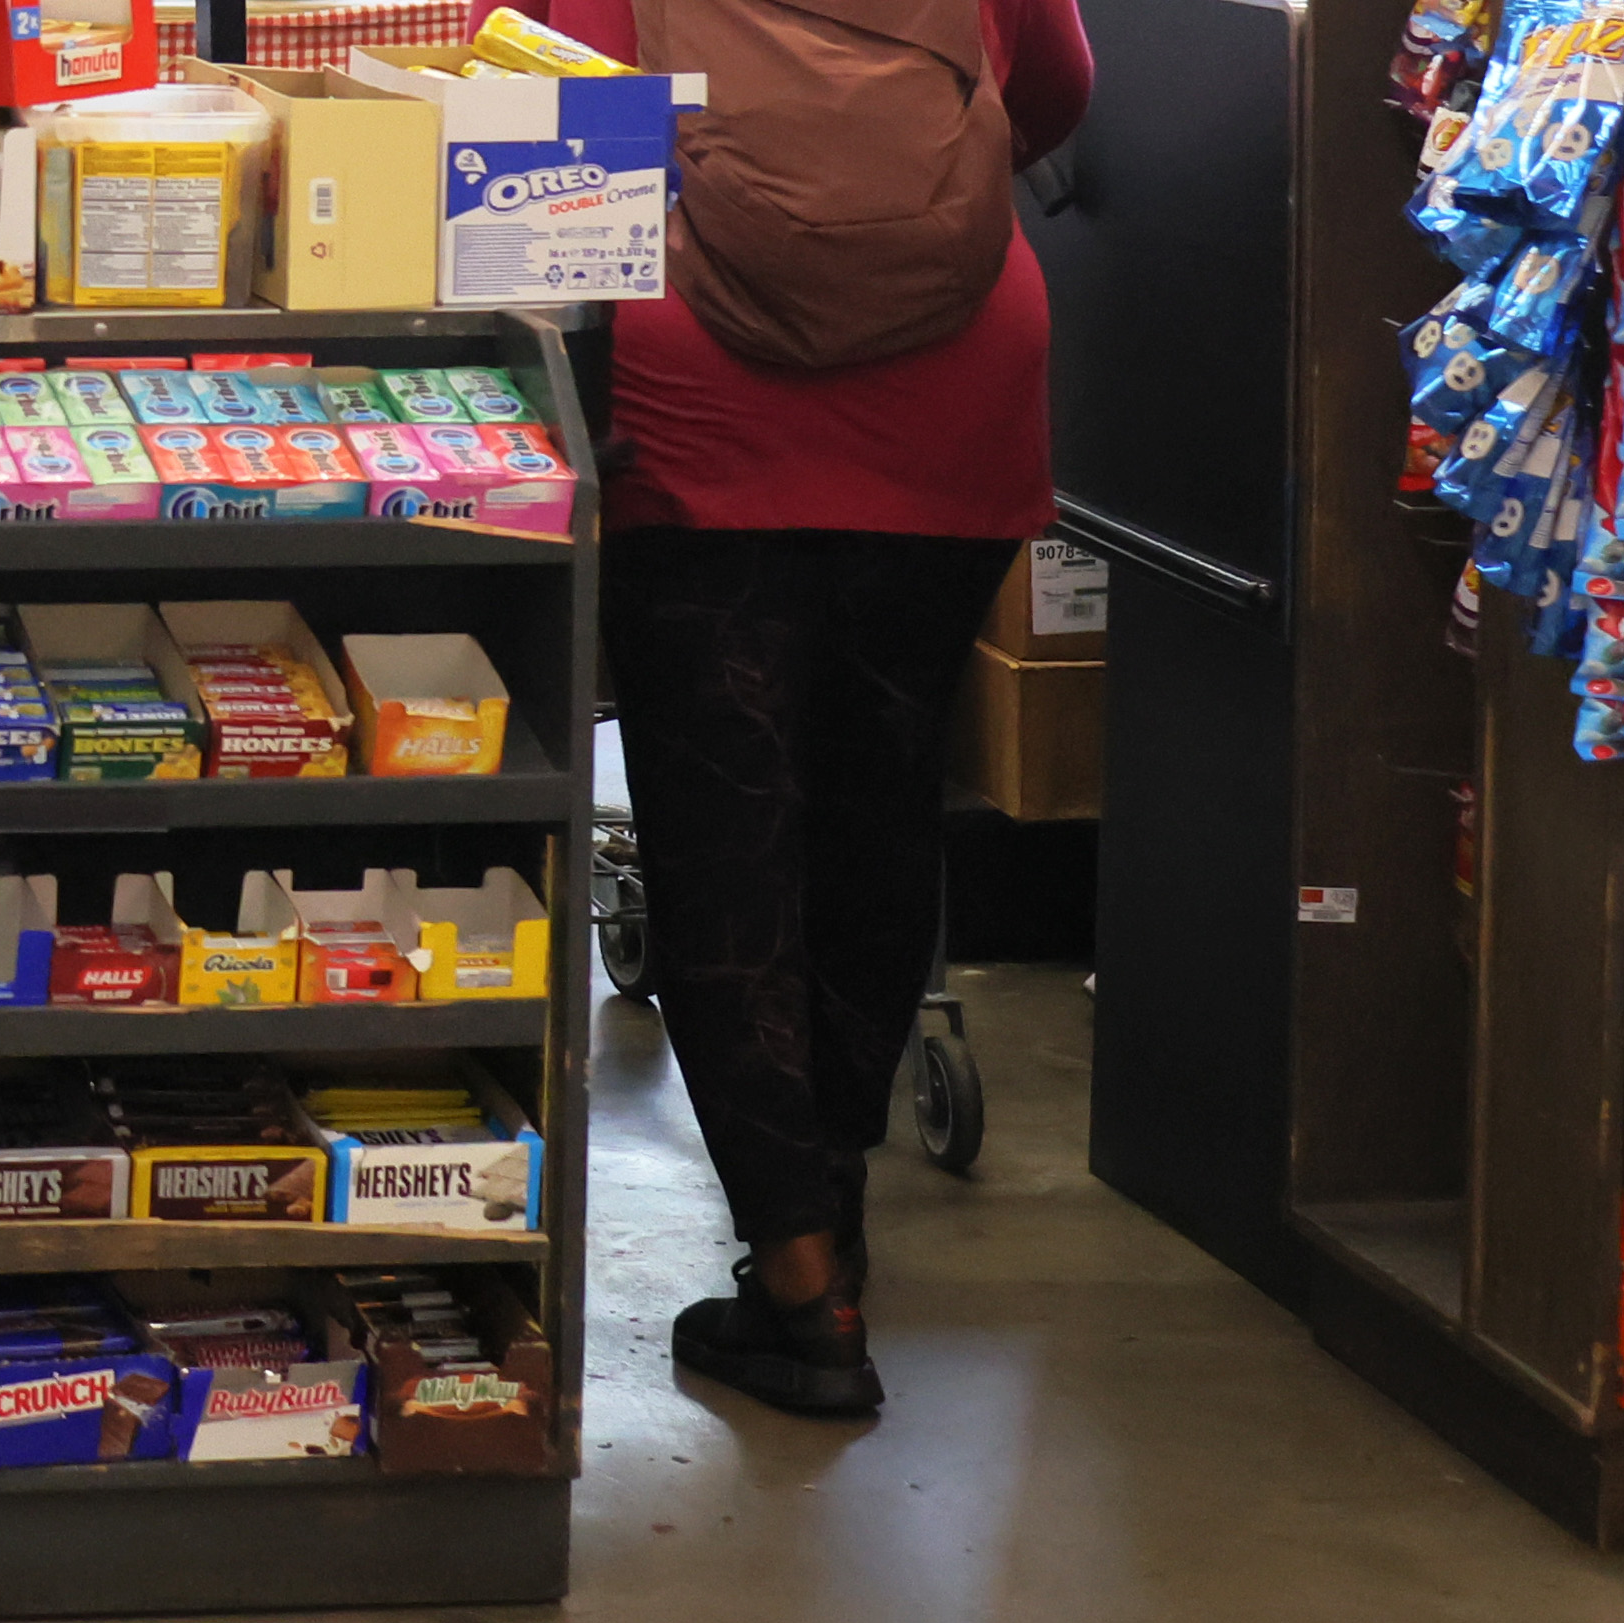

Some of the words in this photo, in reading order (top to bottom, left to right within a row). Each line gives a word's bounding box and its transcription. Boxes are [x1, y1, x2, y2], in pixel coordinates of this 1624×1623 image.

[60, 47, 120, 78] hanuta
[488, 165, 609, 213] OREO
[548, 193, 604, 216] DOUBLE
[381, 488, 477, 519] Orbit
[72, 736, 185, 755] HONEES
[221, 737, 334, 753] HONEES
[396, 737, 482, 757] HALLS
[203, 955, 275, 972] Ricola
[82, 969, 145, 986] HALLS
[156, 1164, 269, 1200] HERSHEY'S
[355, 1162, 472, 1199] HERSHEY'S
